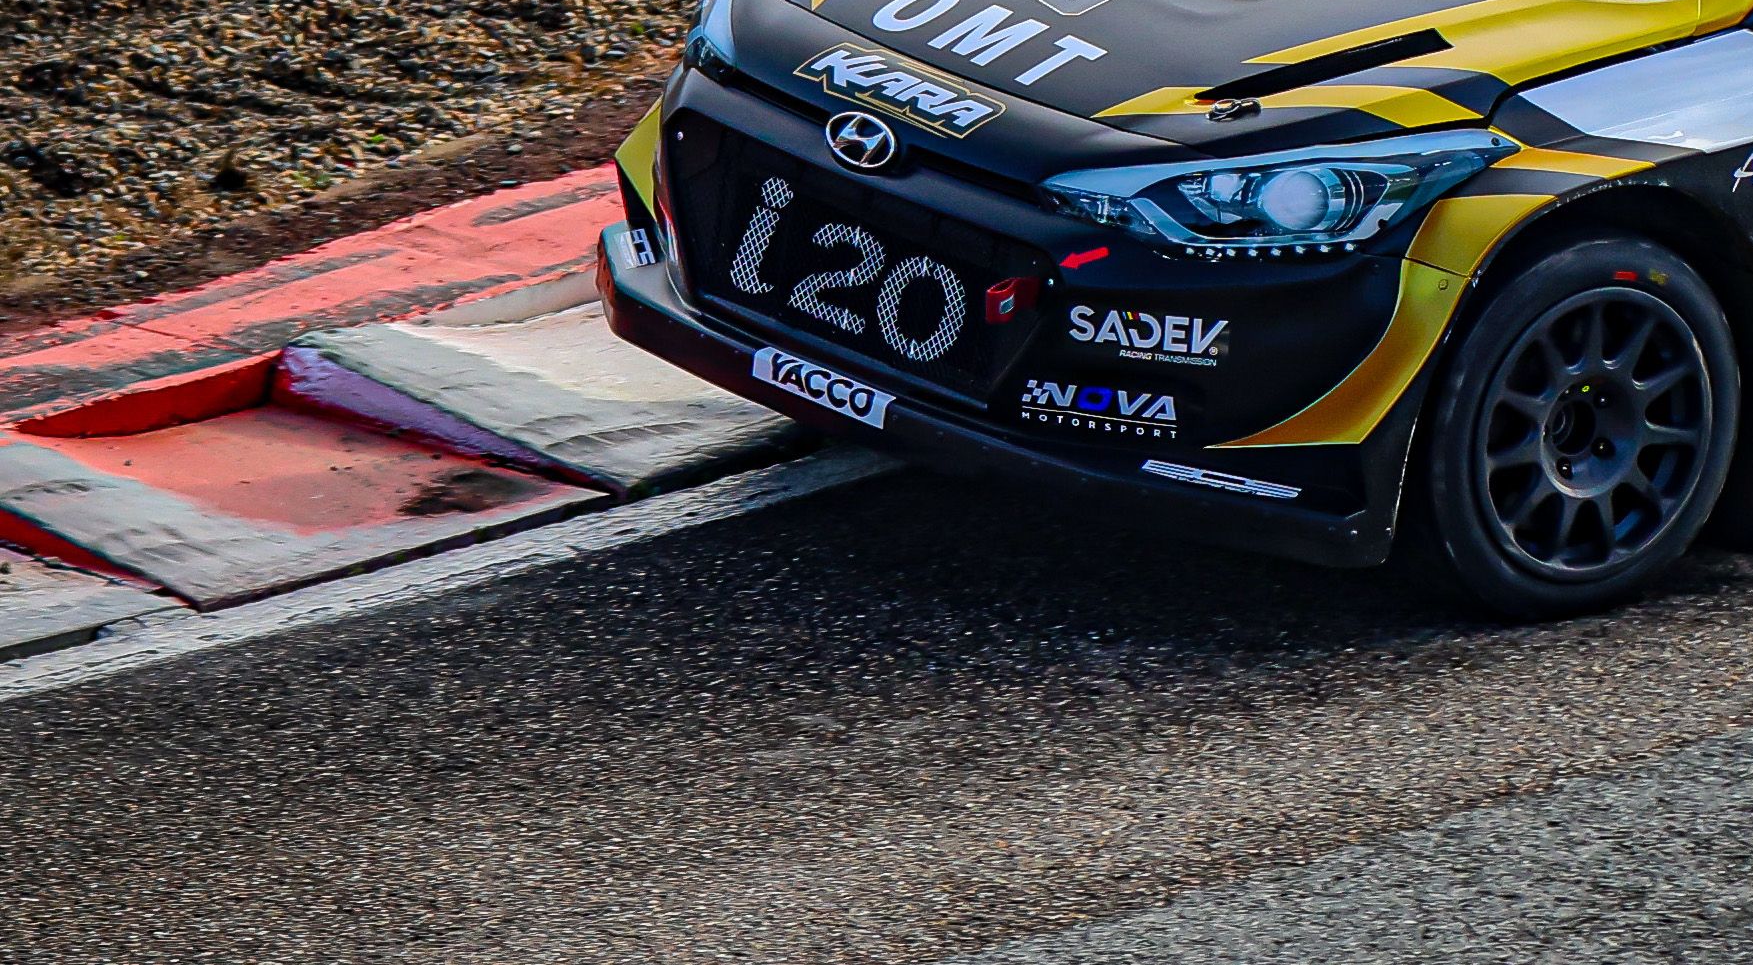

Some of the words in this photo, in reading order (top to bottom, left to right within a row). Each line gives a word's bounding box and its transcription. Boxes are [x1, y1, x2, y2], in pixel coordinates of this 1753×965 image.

[810, 49, 995, 128] KLARA
[729, 175, 968, 363] i20
[769, 352, 877, 418] YACCO
[1037, 381, 1178, 421] NOVA
[1021, 411, 1178, 439] MOTORSPORT
